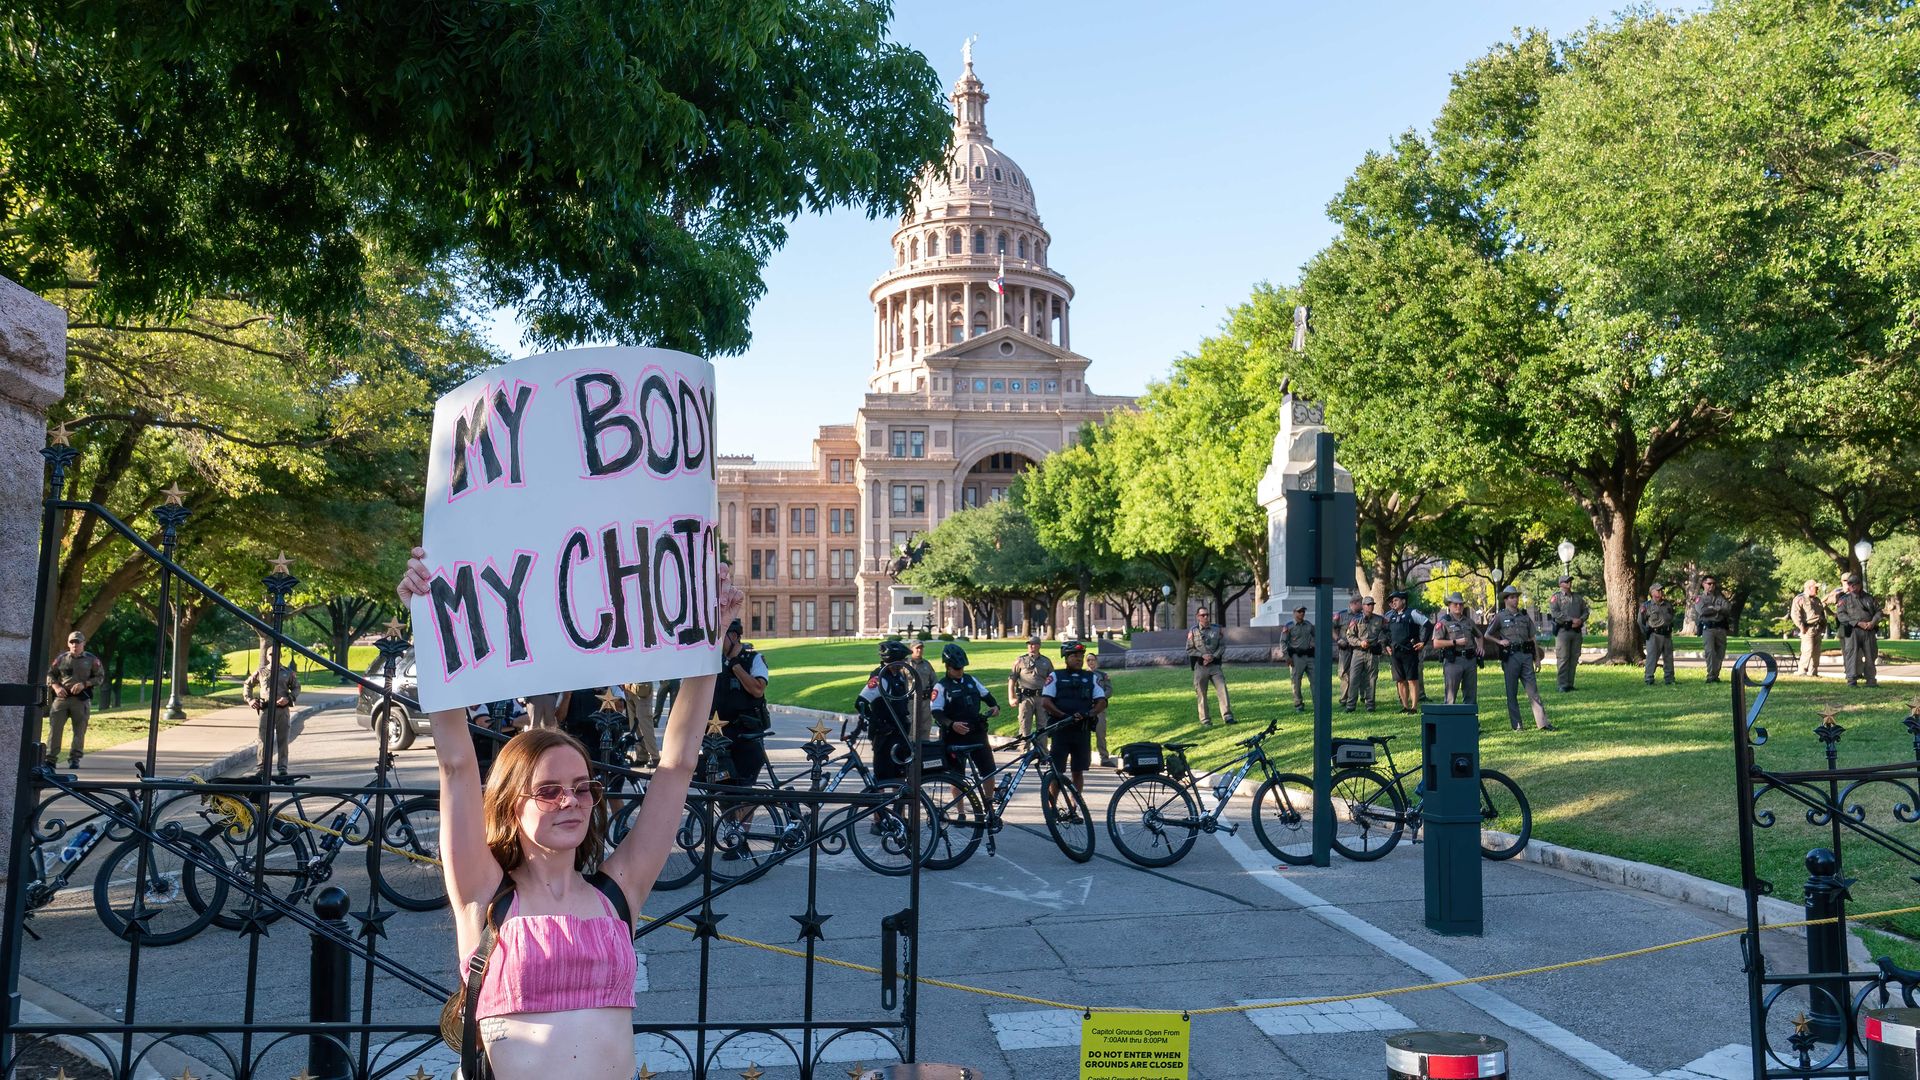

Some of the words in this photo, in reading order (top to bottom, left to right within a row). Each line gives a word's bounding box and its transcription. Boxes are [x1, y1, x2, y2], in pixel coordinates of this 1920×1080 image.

[450, 384, 533, 498] MY
[574, 372, 715, 481] BODY
[429, 552, 533, 676] MY
[558, 518, 721, 650] CHOIC
[1004, 763, 1027, 801] TREK
[1224, 763, 1251, 799] TREK
[1091, 1028, 1114, 1036] Capitol
[1115, 1028, 1143, 1036] Grounds
[1144, 1029, 1162, 1037] Open
[1143, 1036, 1168, 1044] 8:00PM
[1085, 1061, 1129, 1069] GROUNDS
[1130, 1061, 1148, 1069] ARE
[1149, 1061, 1184, 1069] CLOSED
[1123, 1051, 1153, 1059] ENTER
[1154, 1051, 1181, 1059] WHEN
